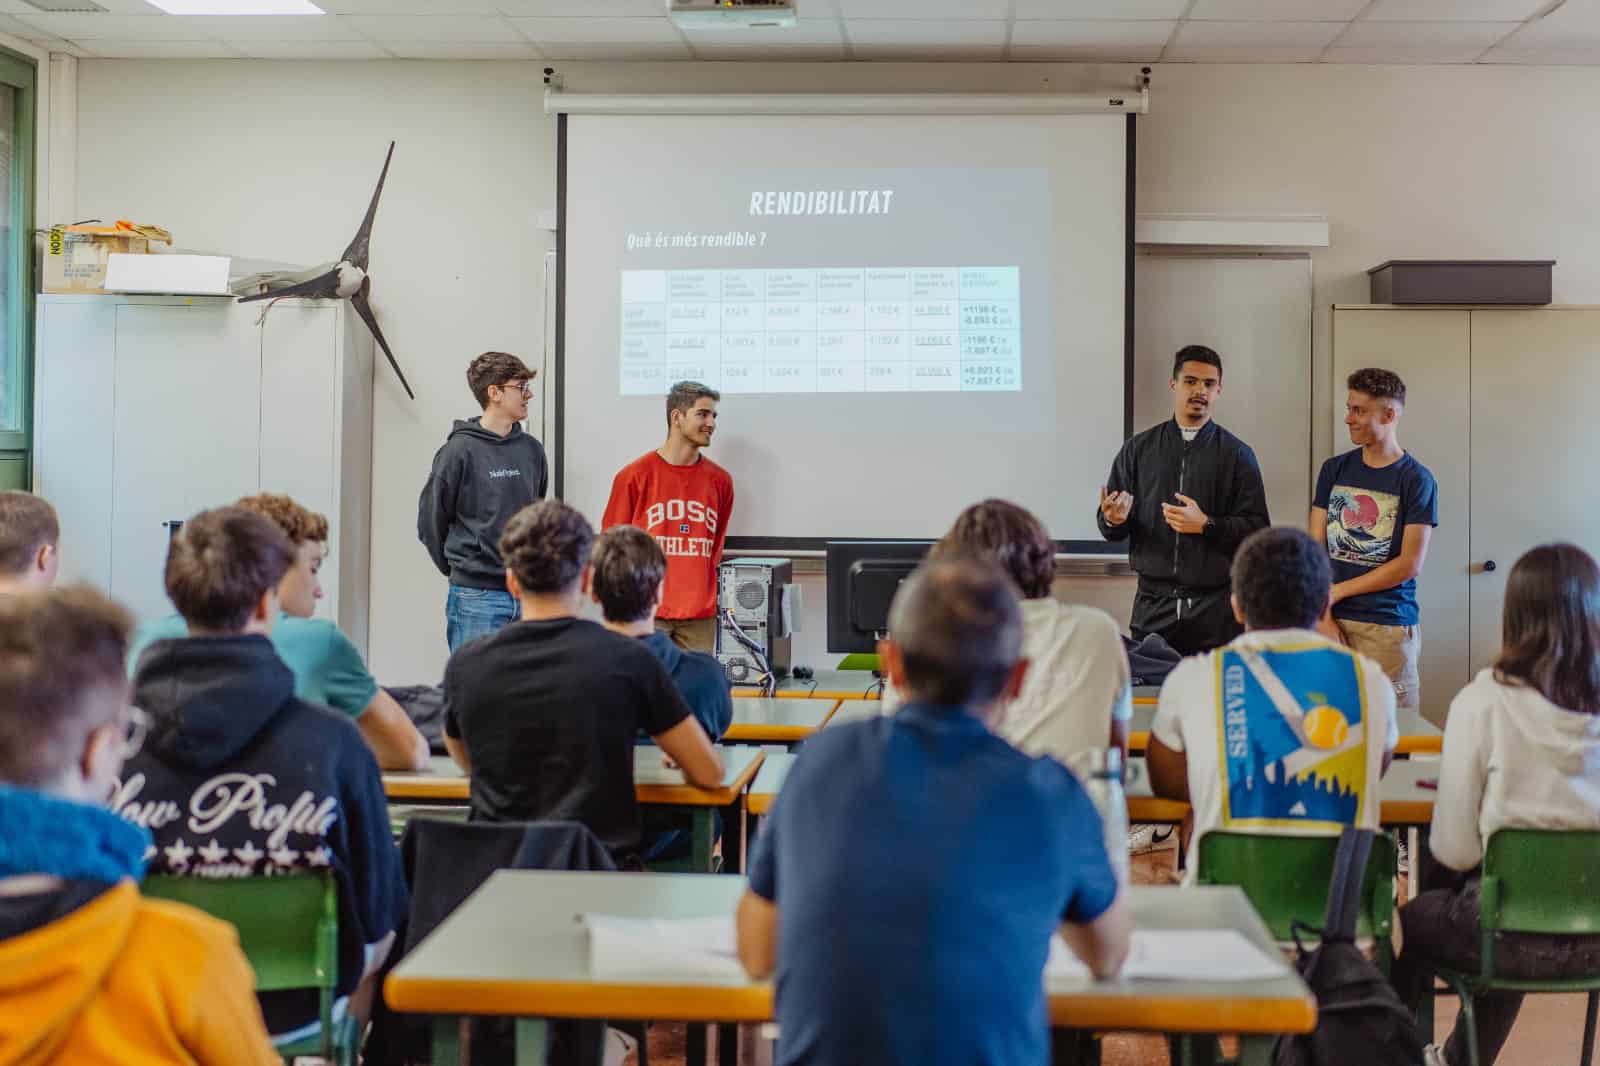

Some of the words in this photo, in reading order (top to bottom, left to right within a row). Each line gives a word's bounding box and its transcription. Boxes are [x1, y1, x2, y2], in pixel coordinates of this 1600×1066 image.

[749, 190, 894, 216] RENDIBILITAT
[626, 233, 651, 250] Què
[655, 232, 668, 248] és
[671, 232, 698, 248] més
[701, 231, 756, 247] rendible
[760, 231, 768, 247] ?
[646, 499, 718, 534] BOSS
[1225, 664, 1248, 758] SERVED
[187, 772, 338, 850] Profile
